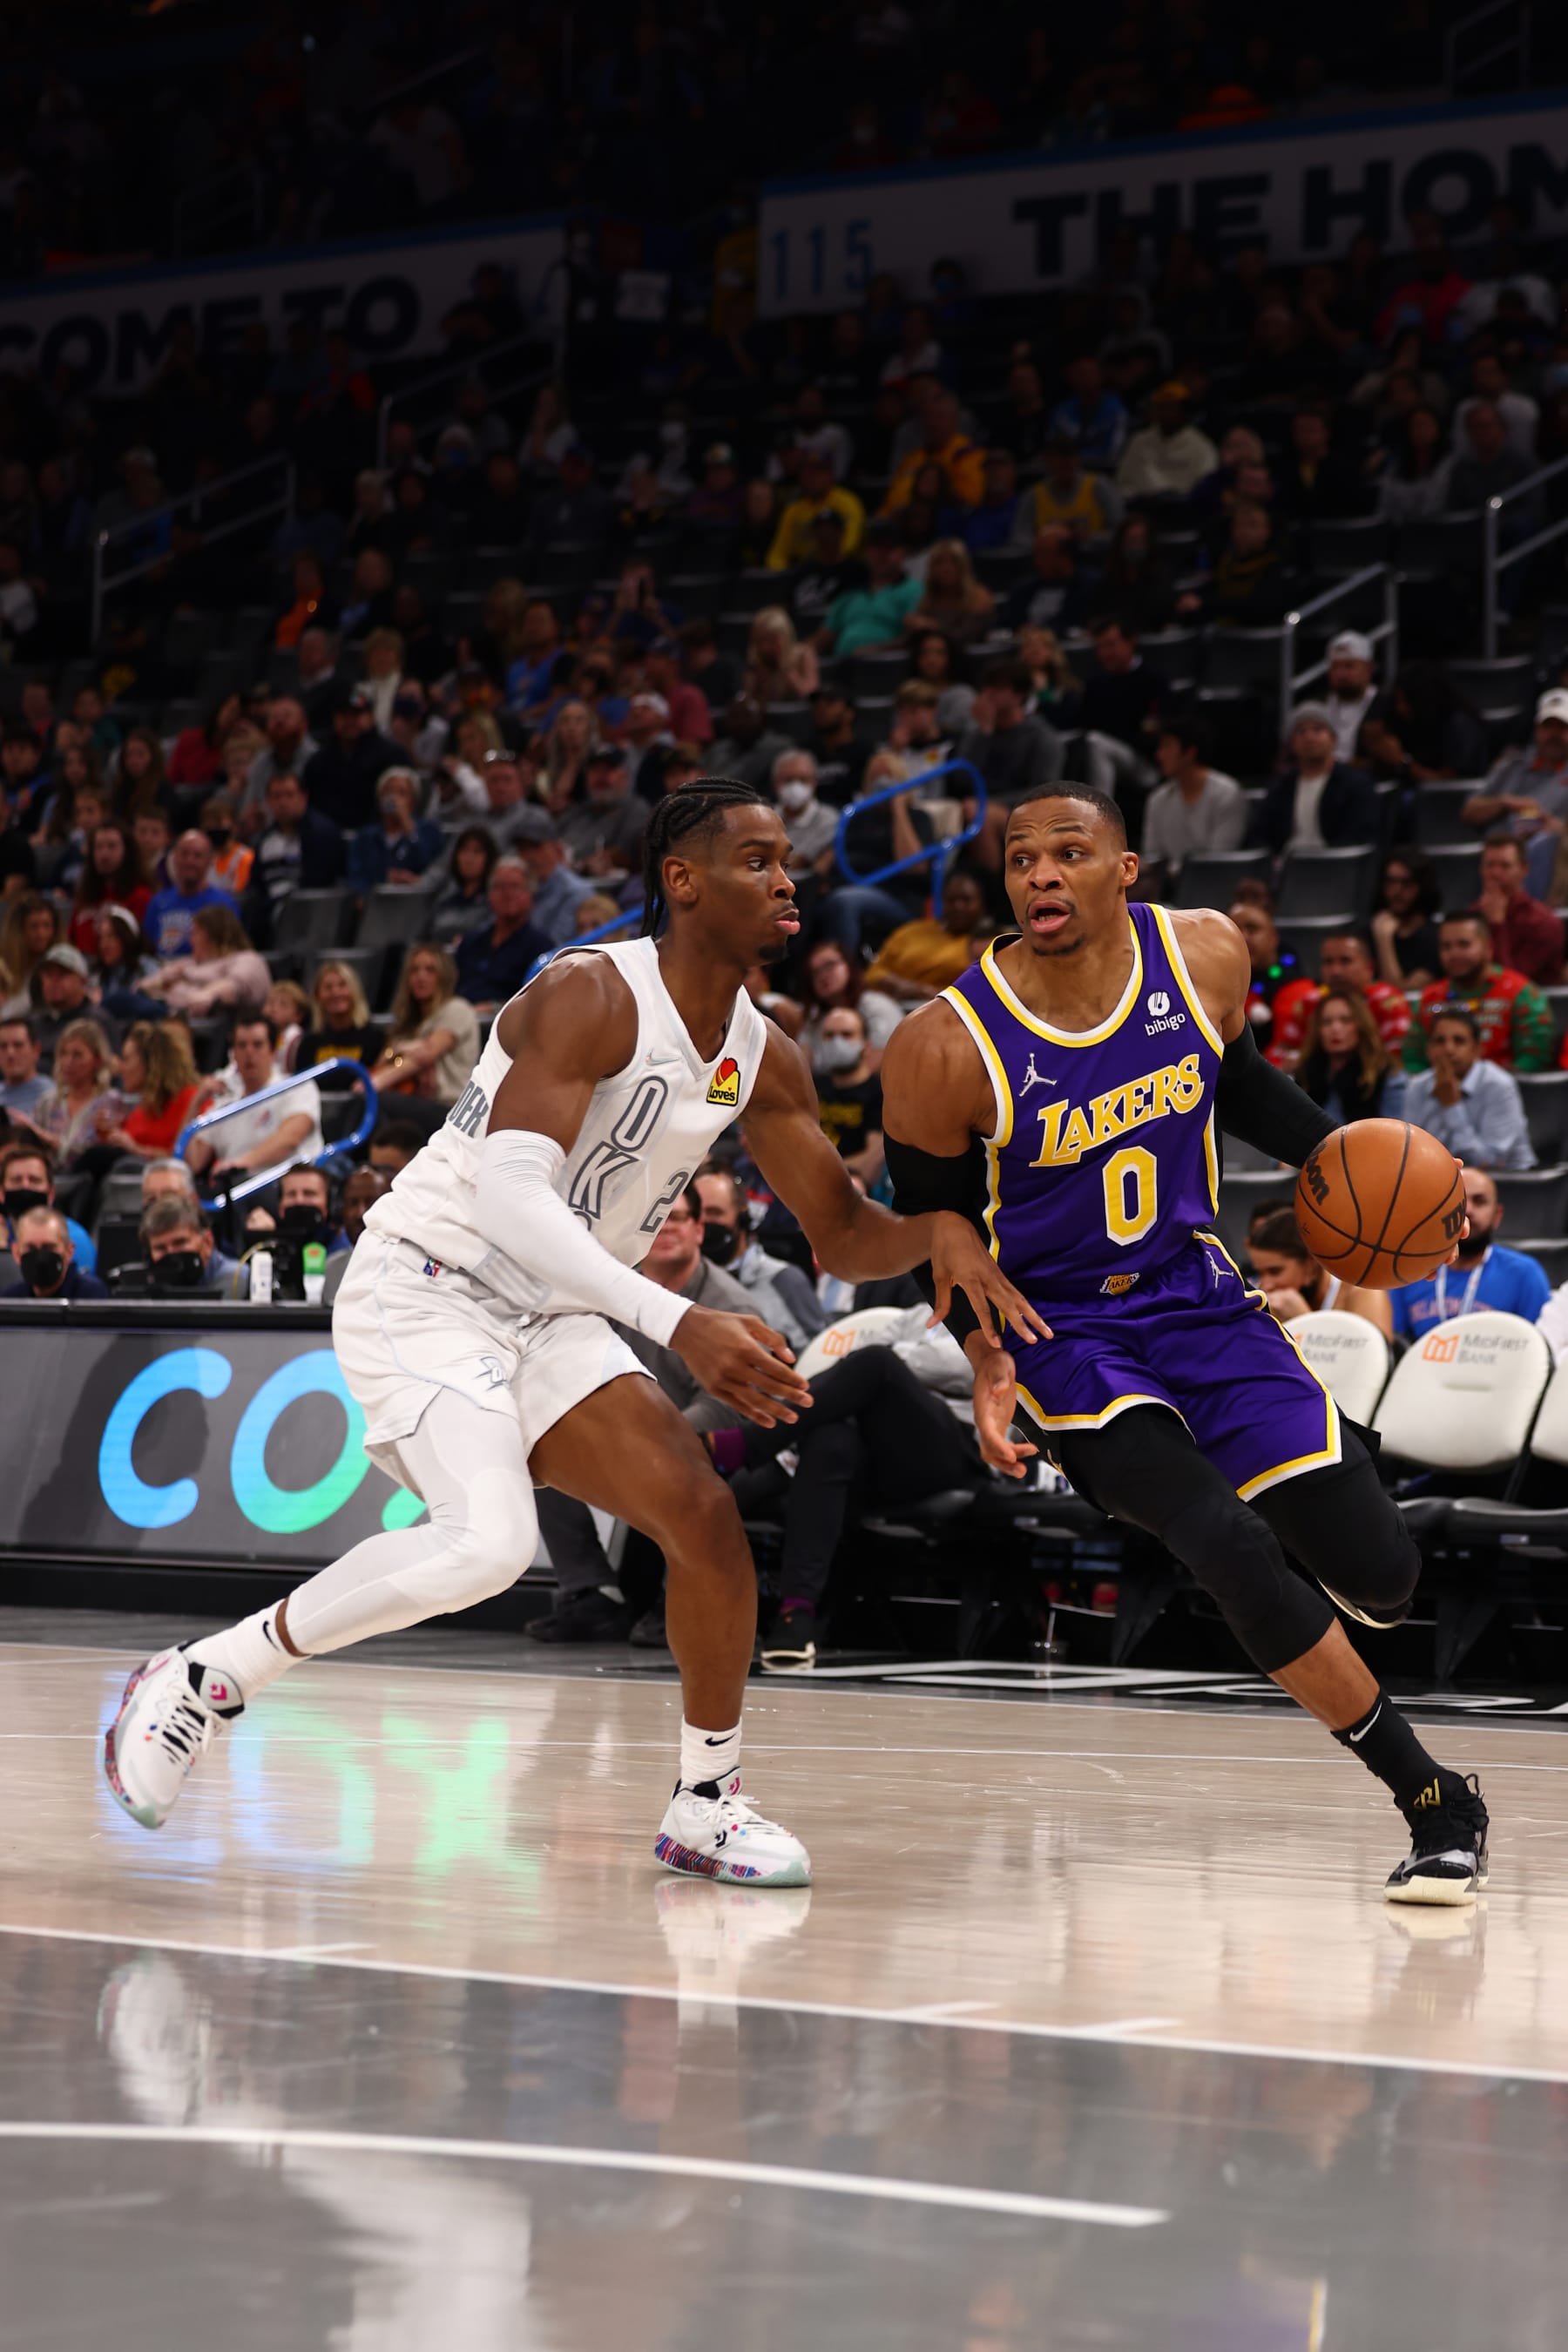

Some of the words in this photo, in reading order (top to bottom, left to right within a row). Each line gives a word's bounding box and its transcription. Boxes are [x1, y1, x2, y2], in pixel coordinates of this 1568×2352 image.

[772, 220, 872, 299] 115
[1014, 172, 1271, 277] THE
[282, 274, 421, 351] TO
[1144, 1012, 1186, 1037] bibigo
[1029, 1053, 1206, 1167] LAKERS
[639, 1171, 690, 1233] 2
[1102, 1145, 1158, 1247] 0
